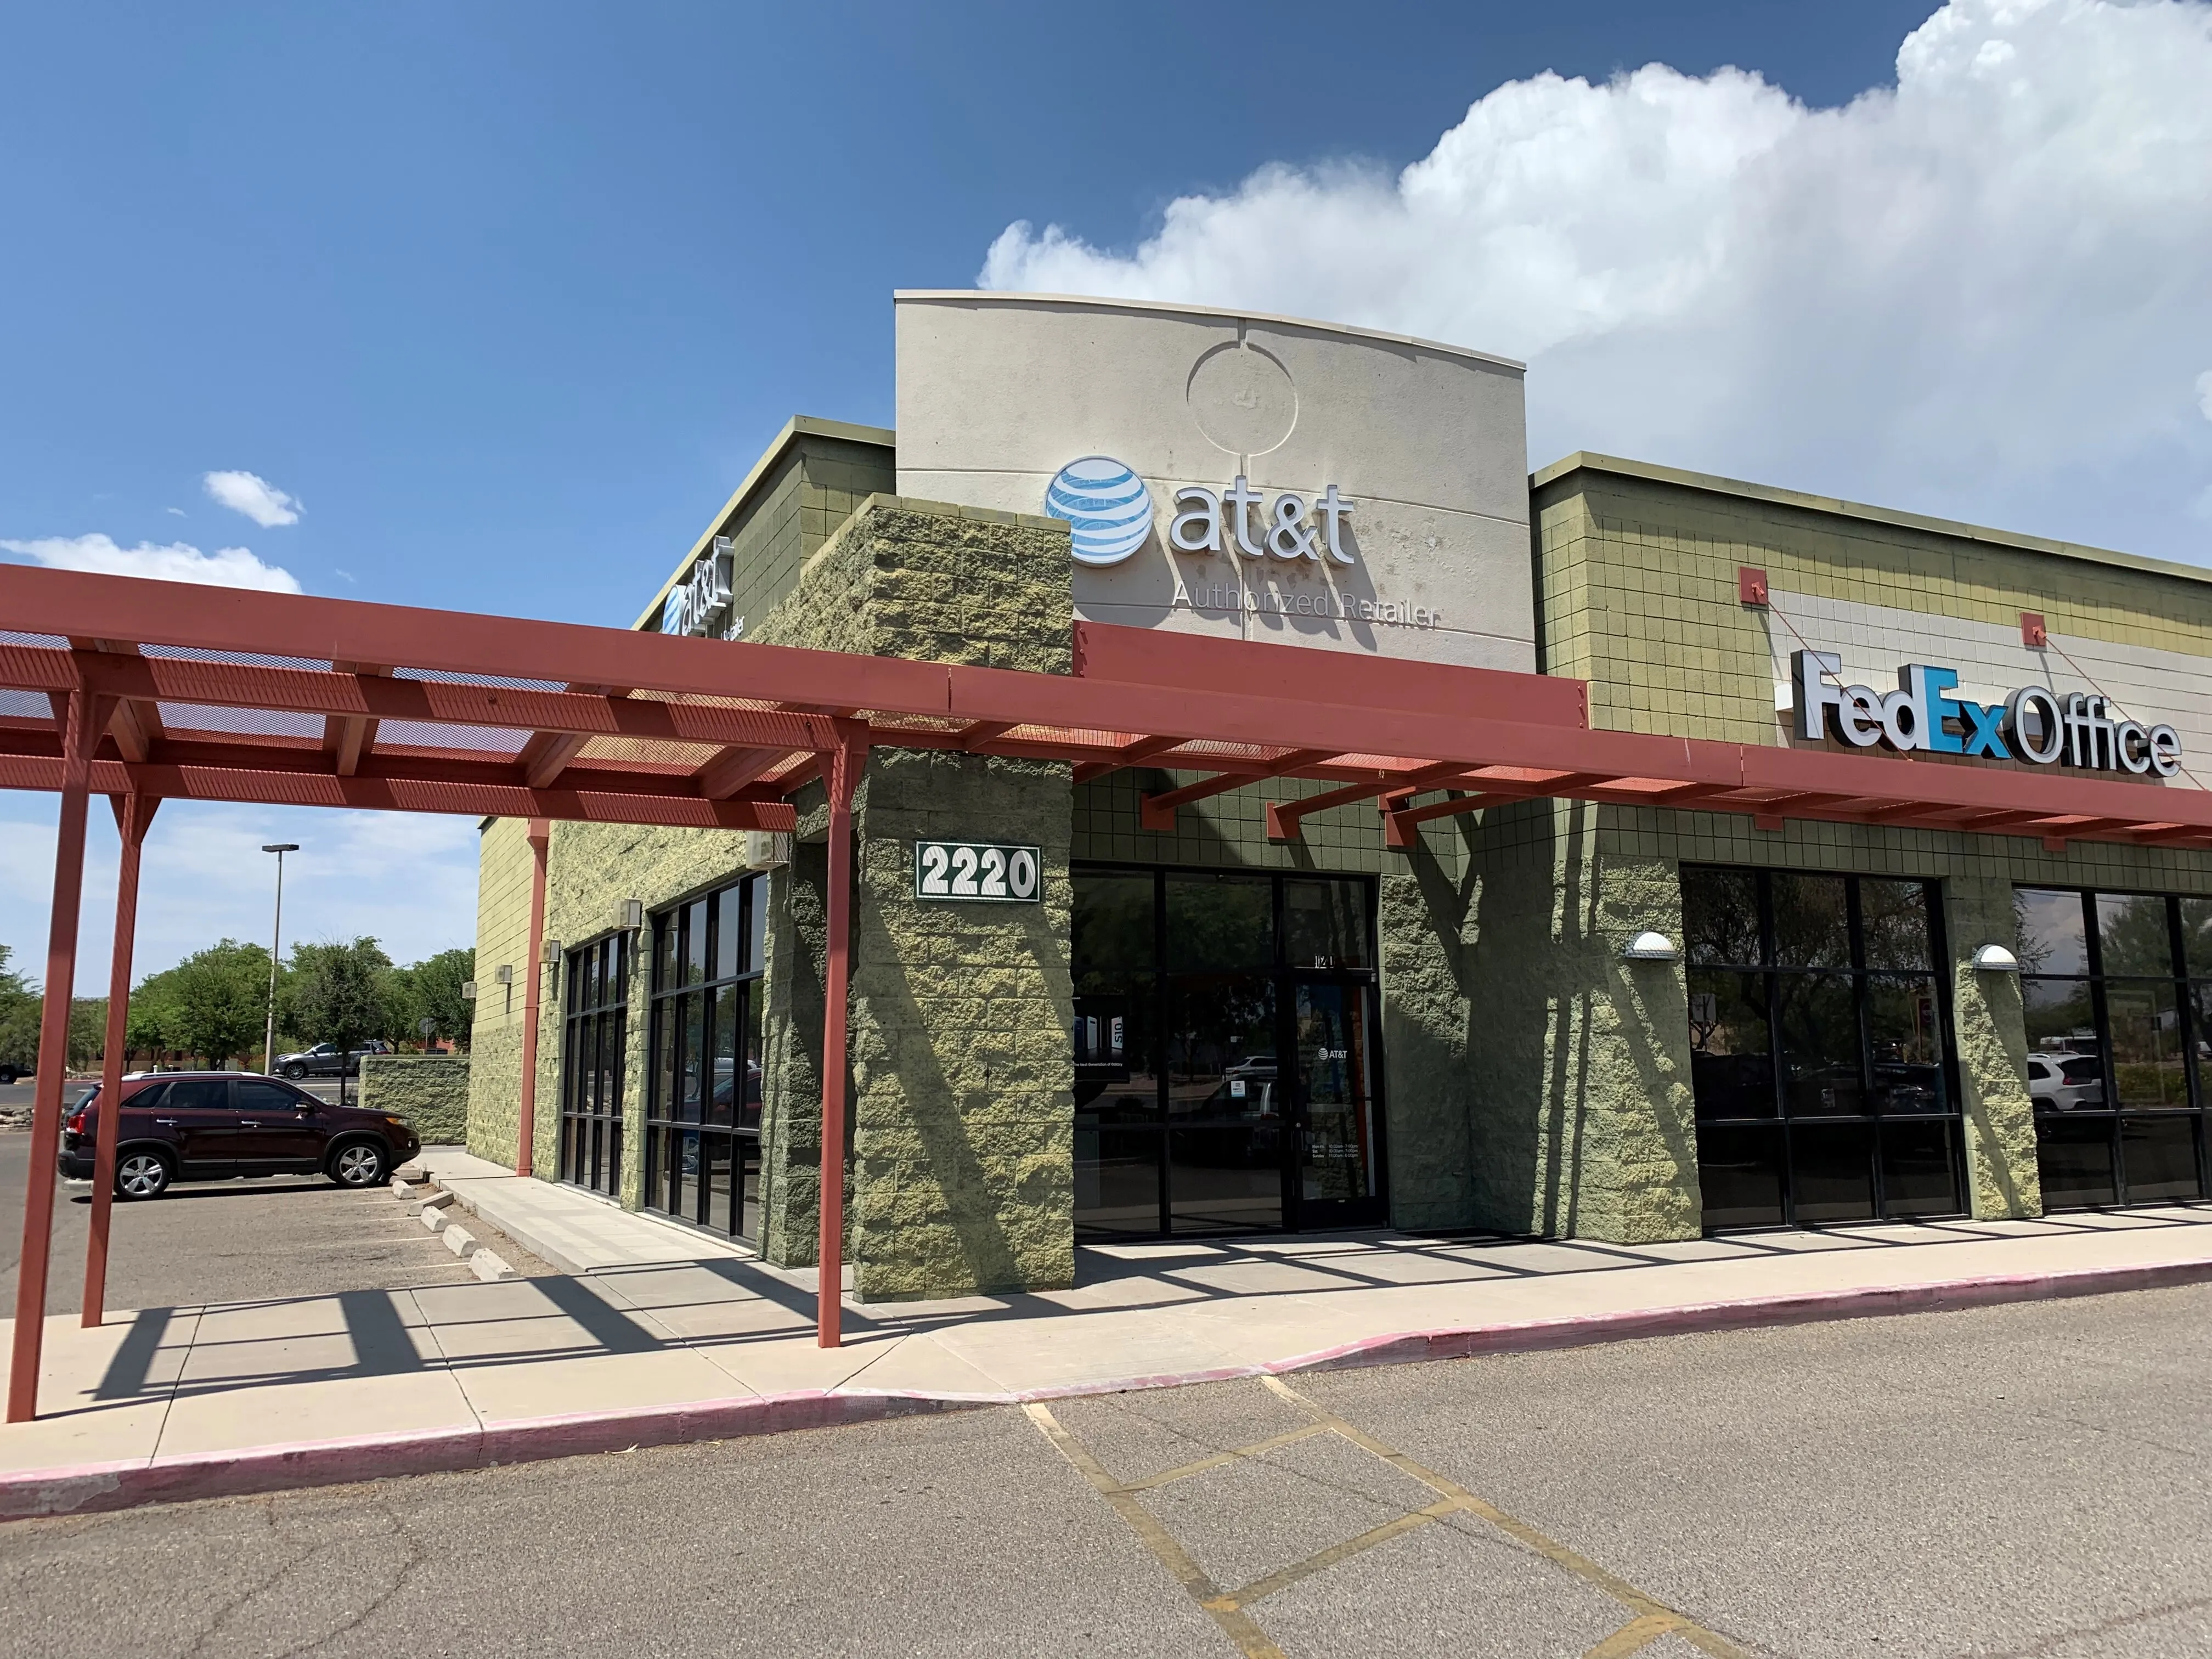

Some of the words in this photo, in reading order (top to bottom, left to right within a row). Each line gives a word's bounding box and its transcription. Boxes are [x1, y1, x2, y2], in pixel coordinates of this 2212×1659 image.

[1169, 475, 1355, 565] at&t
[1171, 579, 1329, 616] Authorized
[1341, 592, 1442, 627] Retailer
[1792, 649, 2012, 760] FedEx
[2007, 685, 2182, 778] Office
[922, 845, 1036, 898] 2220
[1329, 1050, 1347, 1059] AT&T
